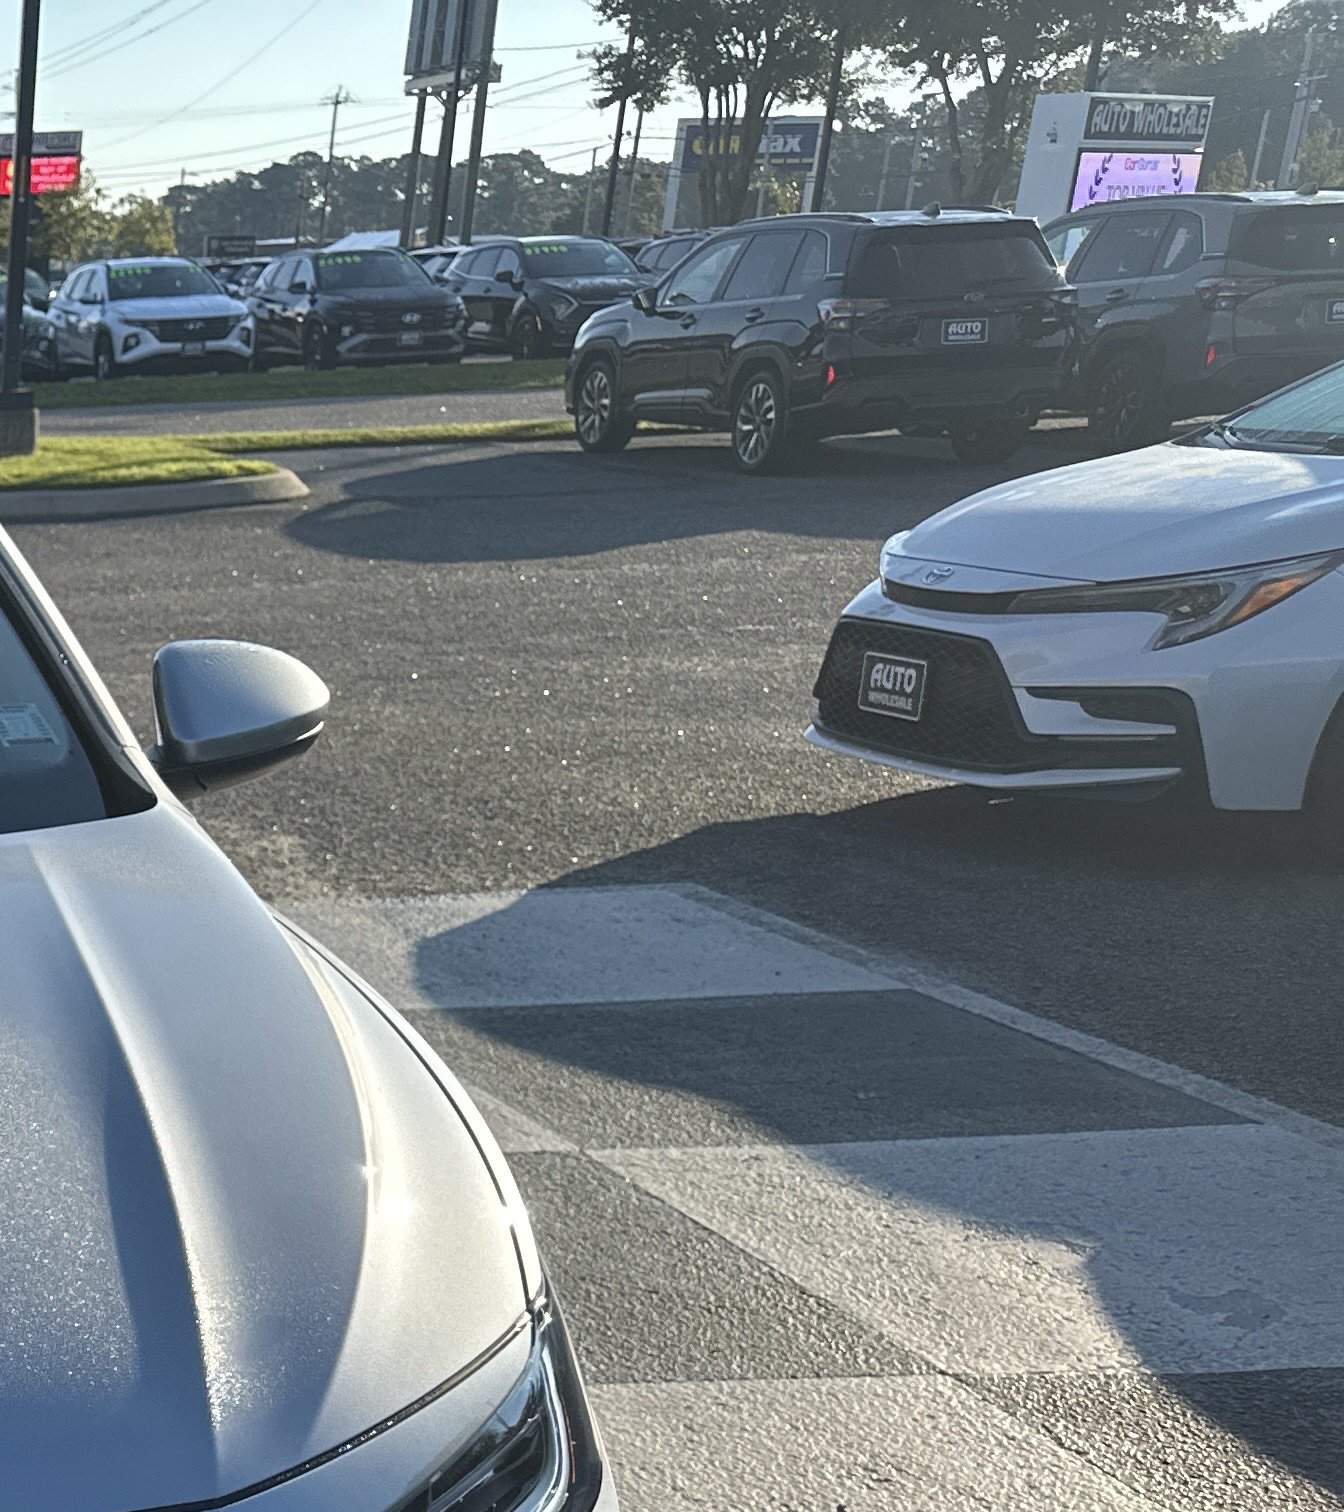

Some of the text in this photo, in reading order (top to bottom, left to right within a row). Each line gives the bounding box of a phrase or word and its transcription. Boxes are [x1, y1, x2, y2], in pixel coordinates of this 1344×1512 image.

[1091, 104, 1130, 133] AUTO
[1133, 103, 1209, 136] WHOLESALE
[948, 322, 981, 334] AUTO
[870, 663, 917, 693] AUTO
